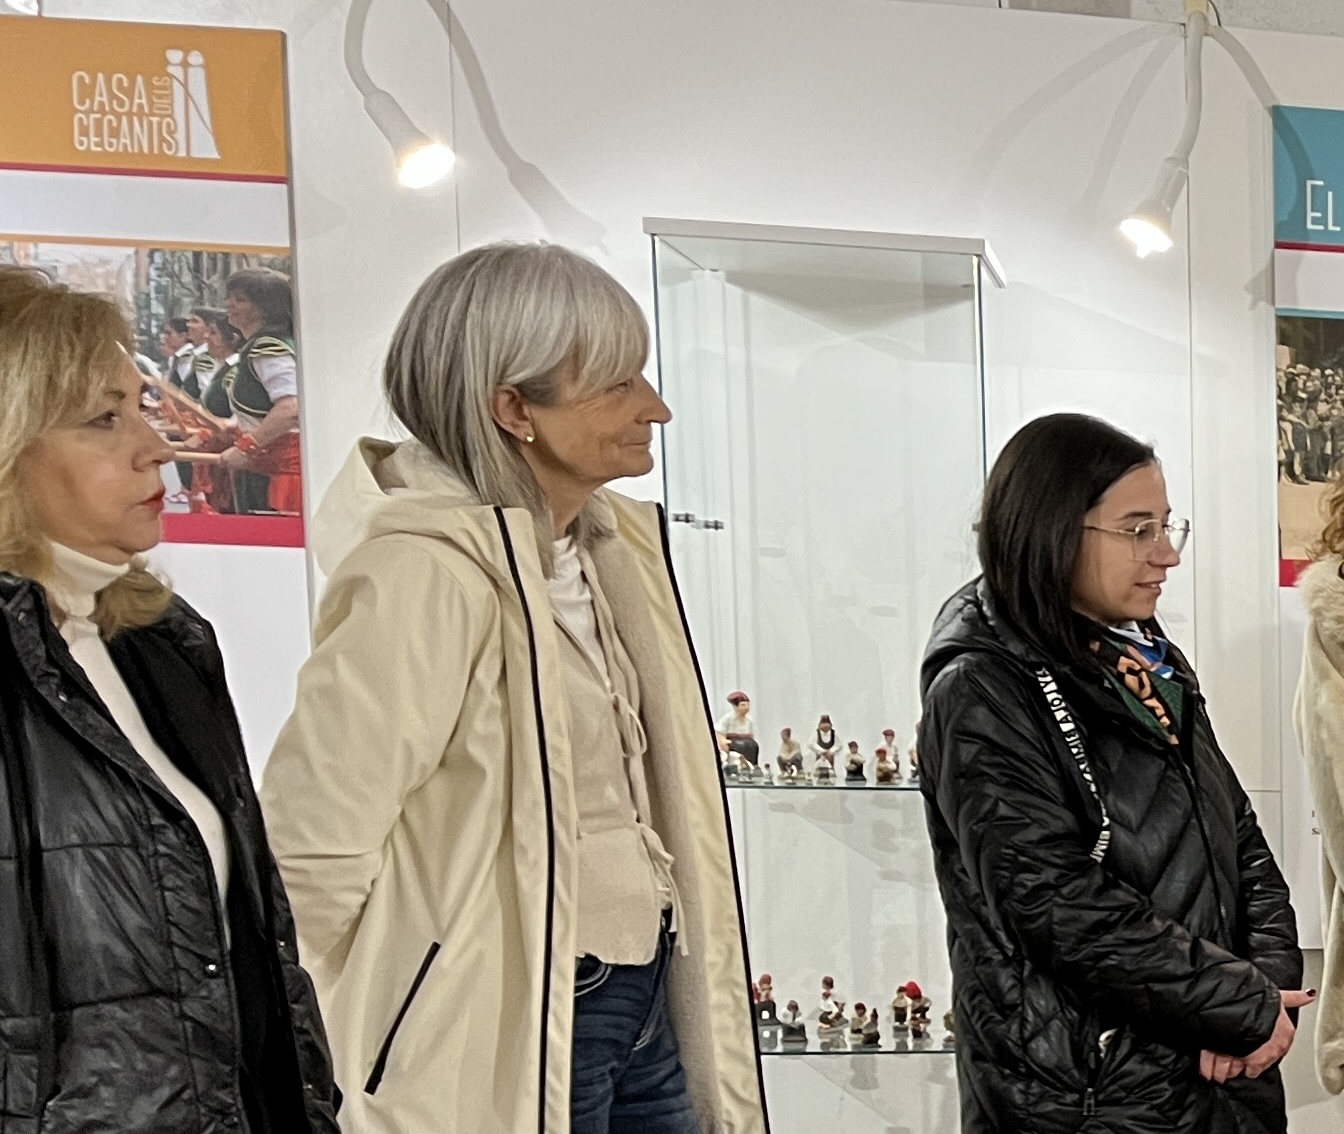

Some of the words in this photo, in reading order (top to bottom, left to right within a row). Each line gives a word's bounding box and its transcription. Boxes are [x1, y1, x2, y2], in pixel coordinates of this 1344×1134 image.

[72, 70, 149, 114] CASA
[152, 76, 172, 115] DELS
[74, 112, 177, 156] GEGANTS
